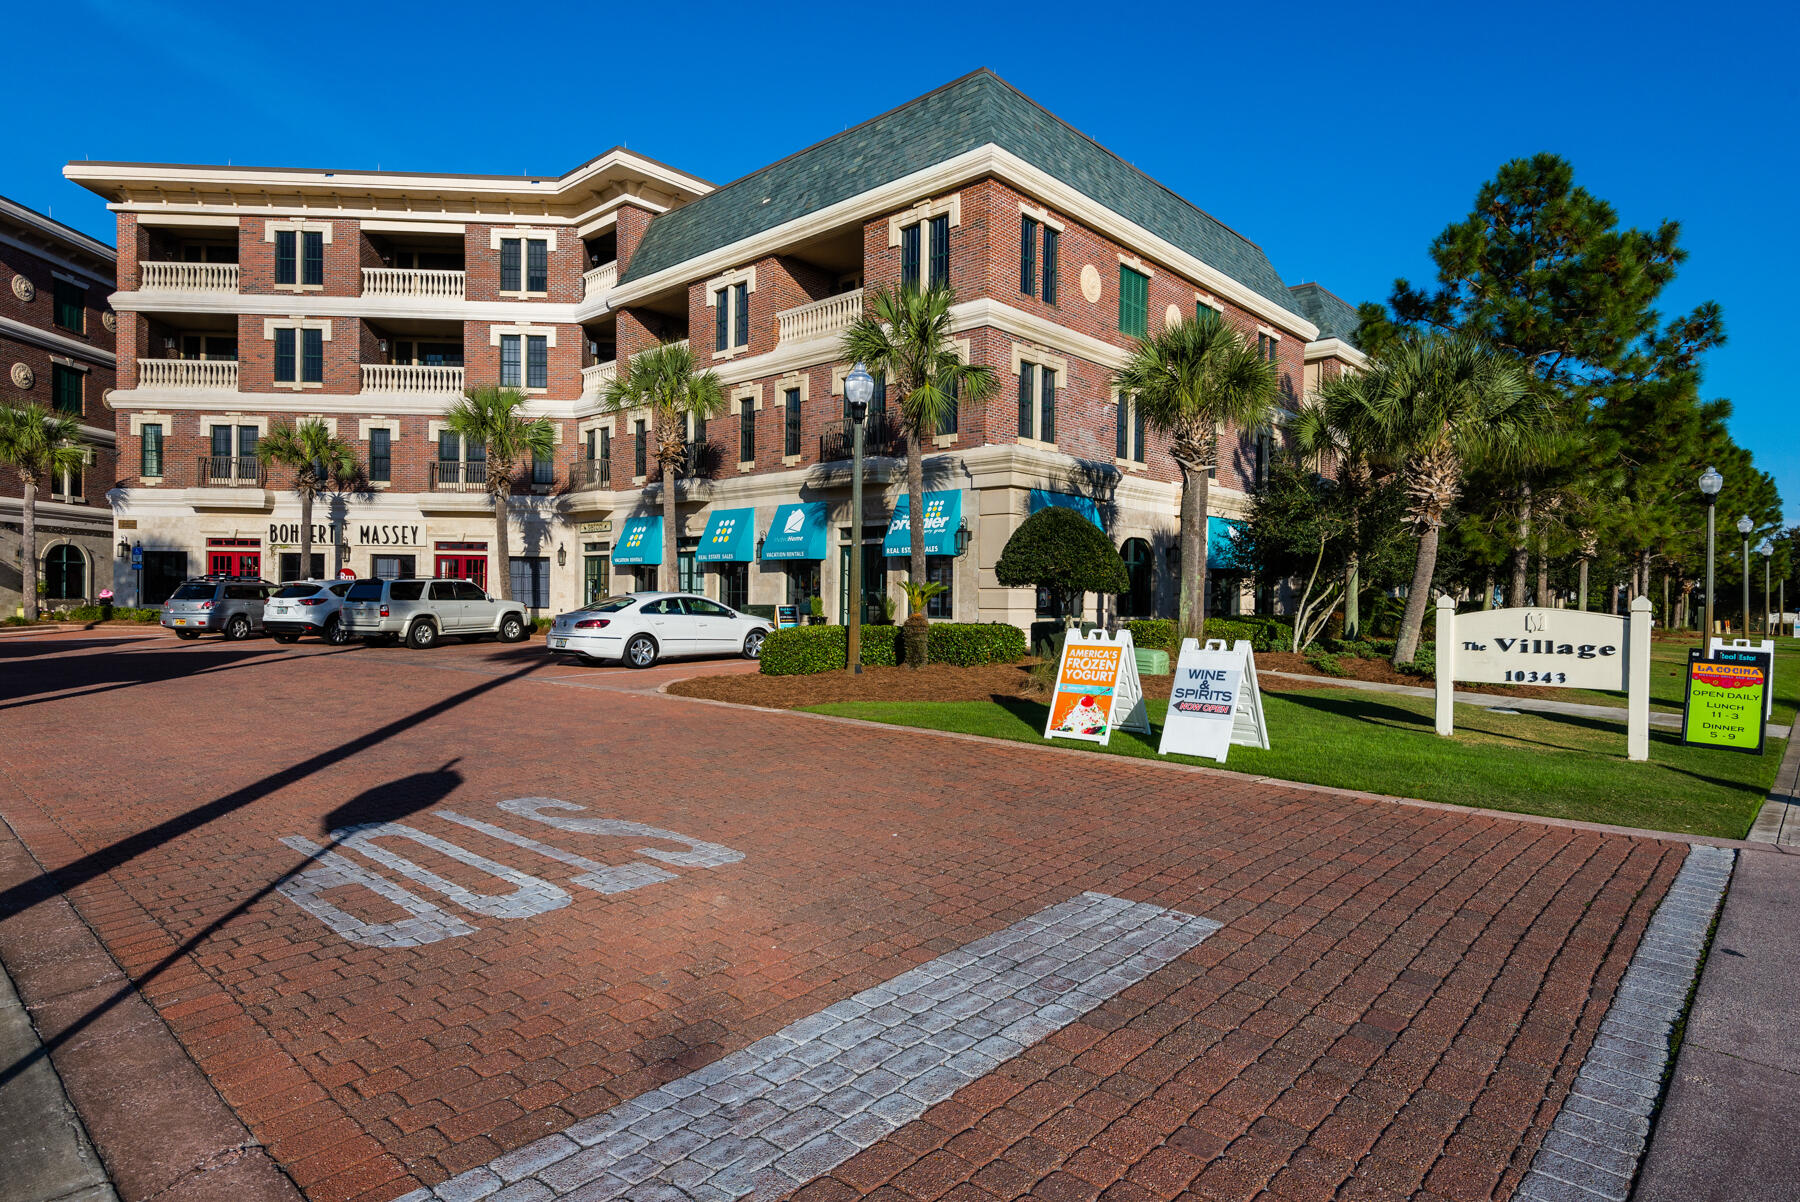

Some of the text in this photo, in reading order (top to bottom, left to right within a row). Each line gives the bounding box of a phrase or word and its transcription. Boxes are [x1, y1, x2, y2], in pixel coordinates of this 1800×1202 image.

[269, 523, 419, 545] BOHERT MASSEY
[1068, 648, 1118, 659] AMERICA'S
[1462, 638, 1616, 659] The Village
[1066, 657, 1116, 671] FROZEN
[1065, 669, 1114, 682] YOGURT
[1189, 669, 1227, 681] WINE
[1716, 666, 1759, 675] COCINA
[1504, 670, 1566, 684] 10343
[1199, 680, 1210, 690] &
[1174, 688, 1232, 702] SPIRITS
[1692, 690, 1760, 701] OPEN DAILY
[1179, 702, 1229, 714] NOW OPEN
[1706, 701, 1744, 711] LUNCH
[1702, 722, 1745, 732] DINNER
[276, 796, 746, 948] STOP
